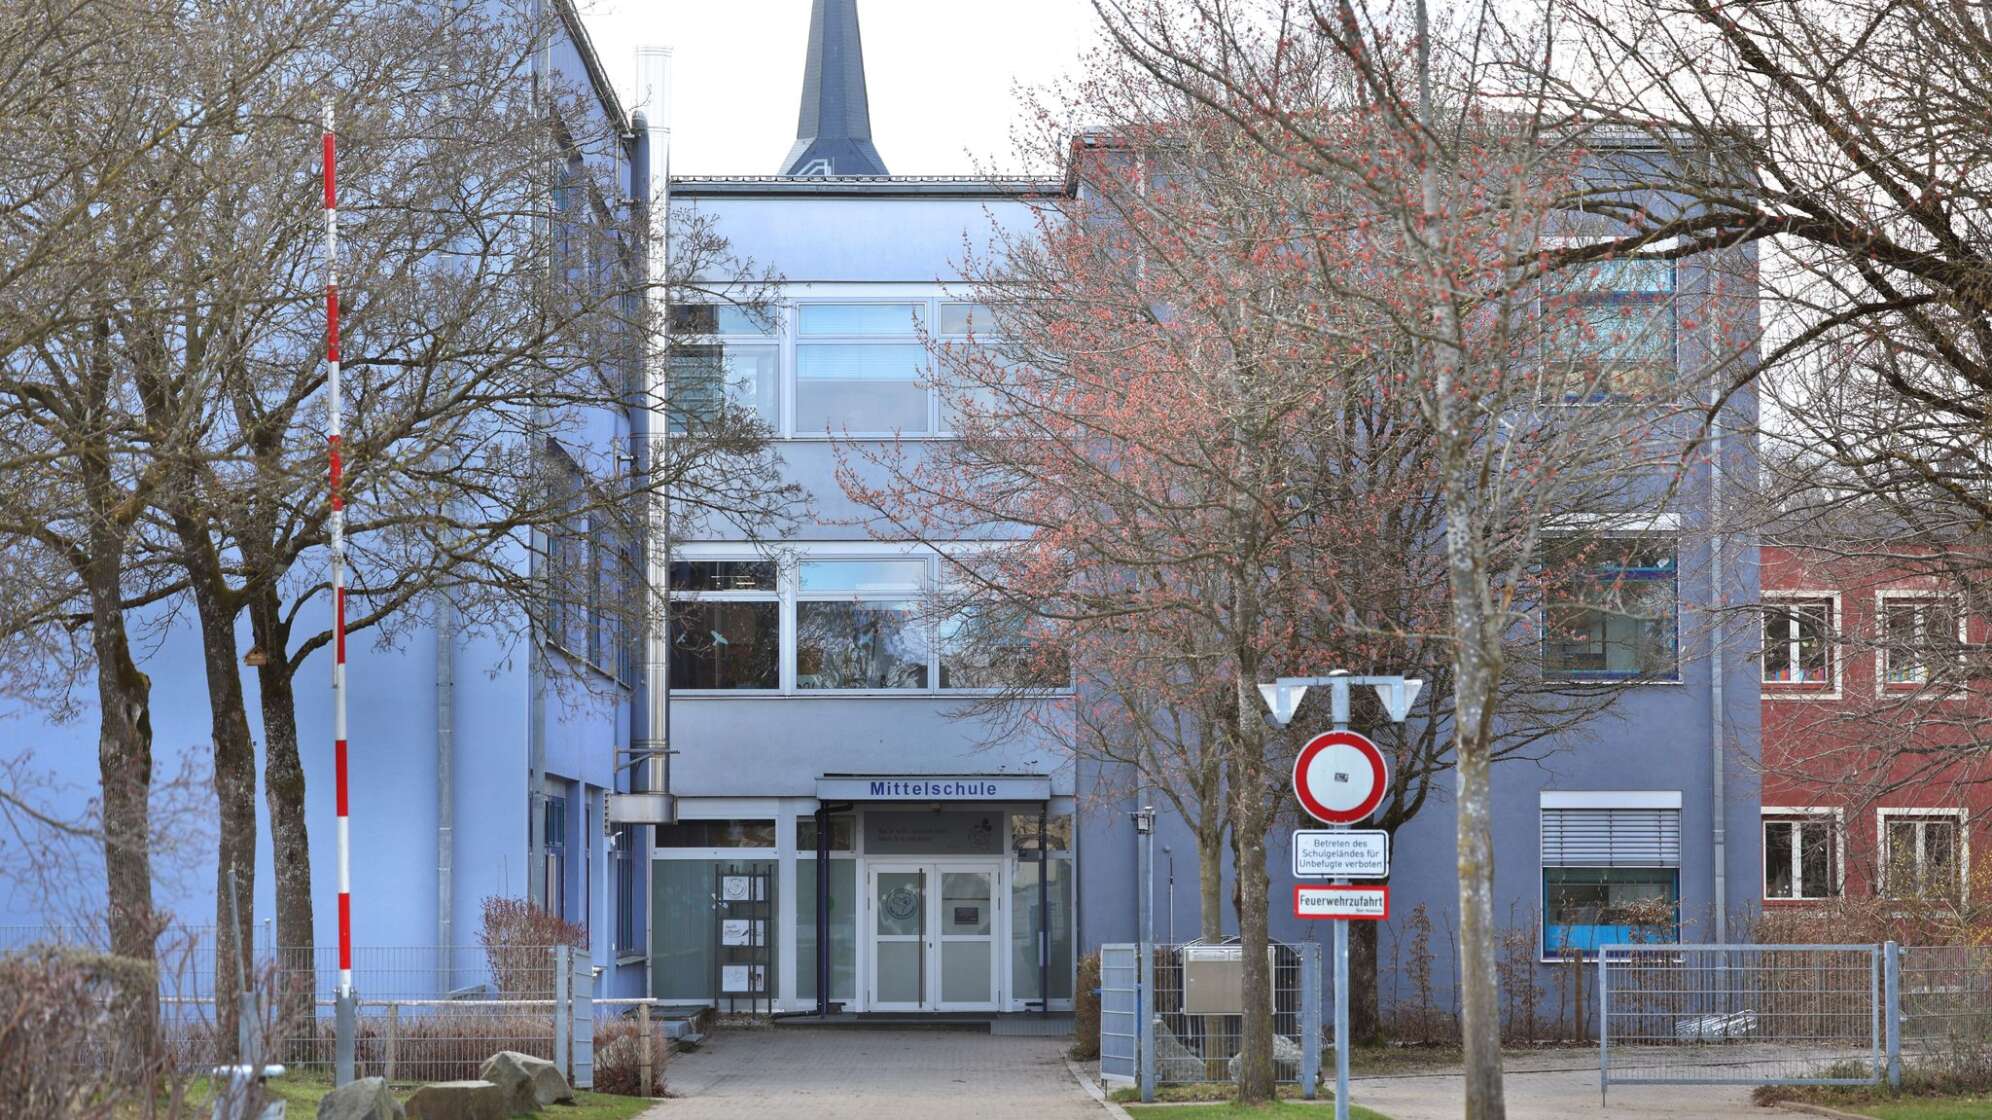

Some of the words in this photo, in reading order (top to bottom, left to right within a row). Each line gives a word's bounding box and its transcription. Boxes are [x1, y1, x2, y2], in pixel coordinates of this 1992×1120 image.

[870, 781, 997, 796] Mittelschule
[1314, 839, 1351, 848] Betreten
[1352, 839, 1368, 848] des
[1302, 848, 1364, 859] Schulgeländes
[1366, 849, 1380, 858] für
[1299, 859, 1343, 870] Unbefugte
[1345, 859, 1382, 869] verboten
[1300, 894, 1383, 907] Feuerwehrzufahrt
